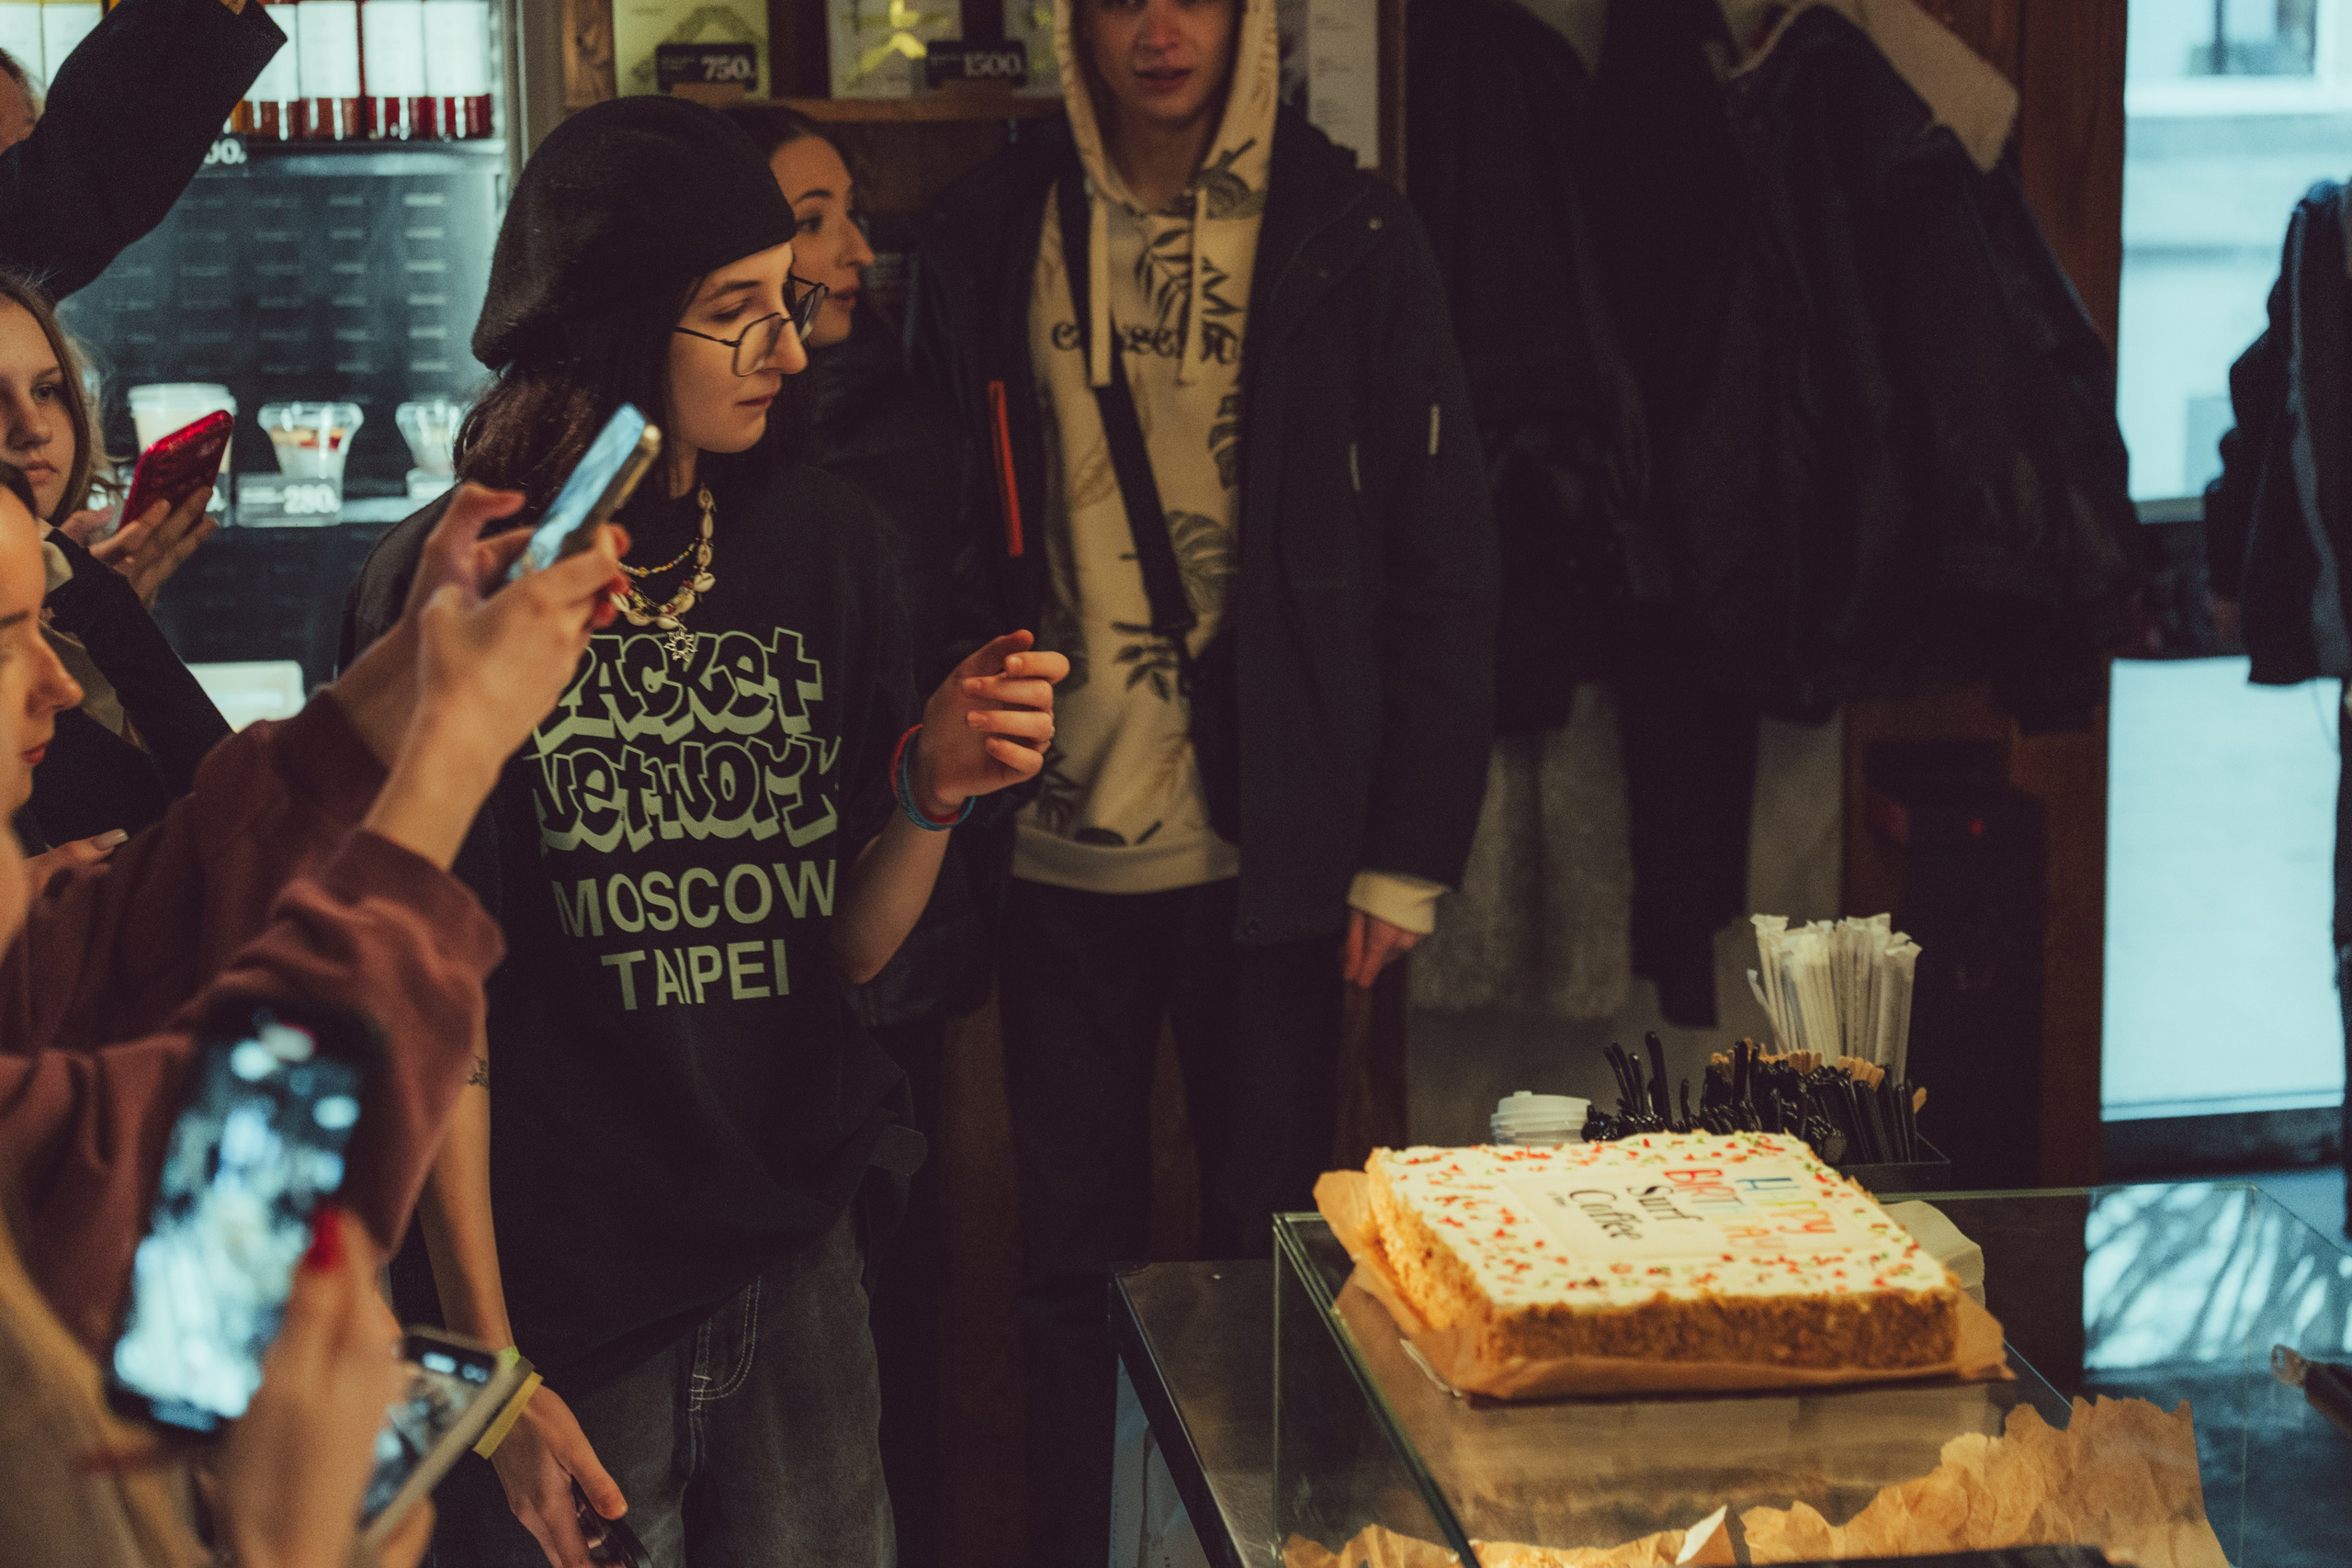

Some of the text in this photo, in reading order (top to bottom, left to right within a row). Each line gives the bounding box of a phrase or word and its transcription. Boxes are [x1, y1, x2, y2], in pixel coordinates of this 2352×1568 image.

[551, 858, 837, 938] MOSCOW
[600, 939, 790, 1011] TAIPEI
[1569, 1189, 1643, 1240] Coffee
[1626, 1185, 1704, 1222] Surf
